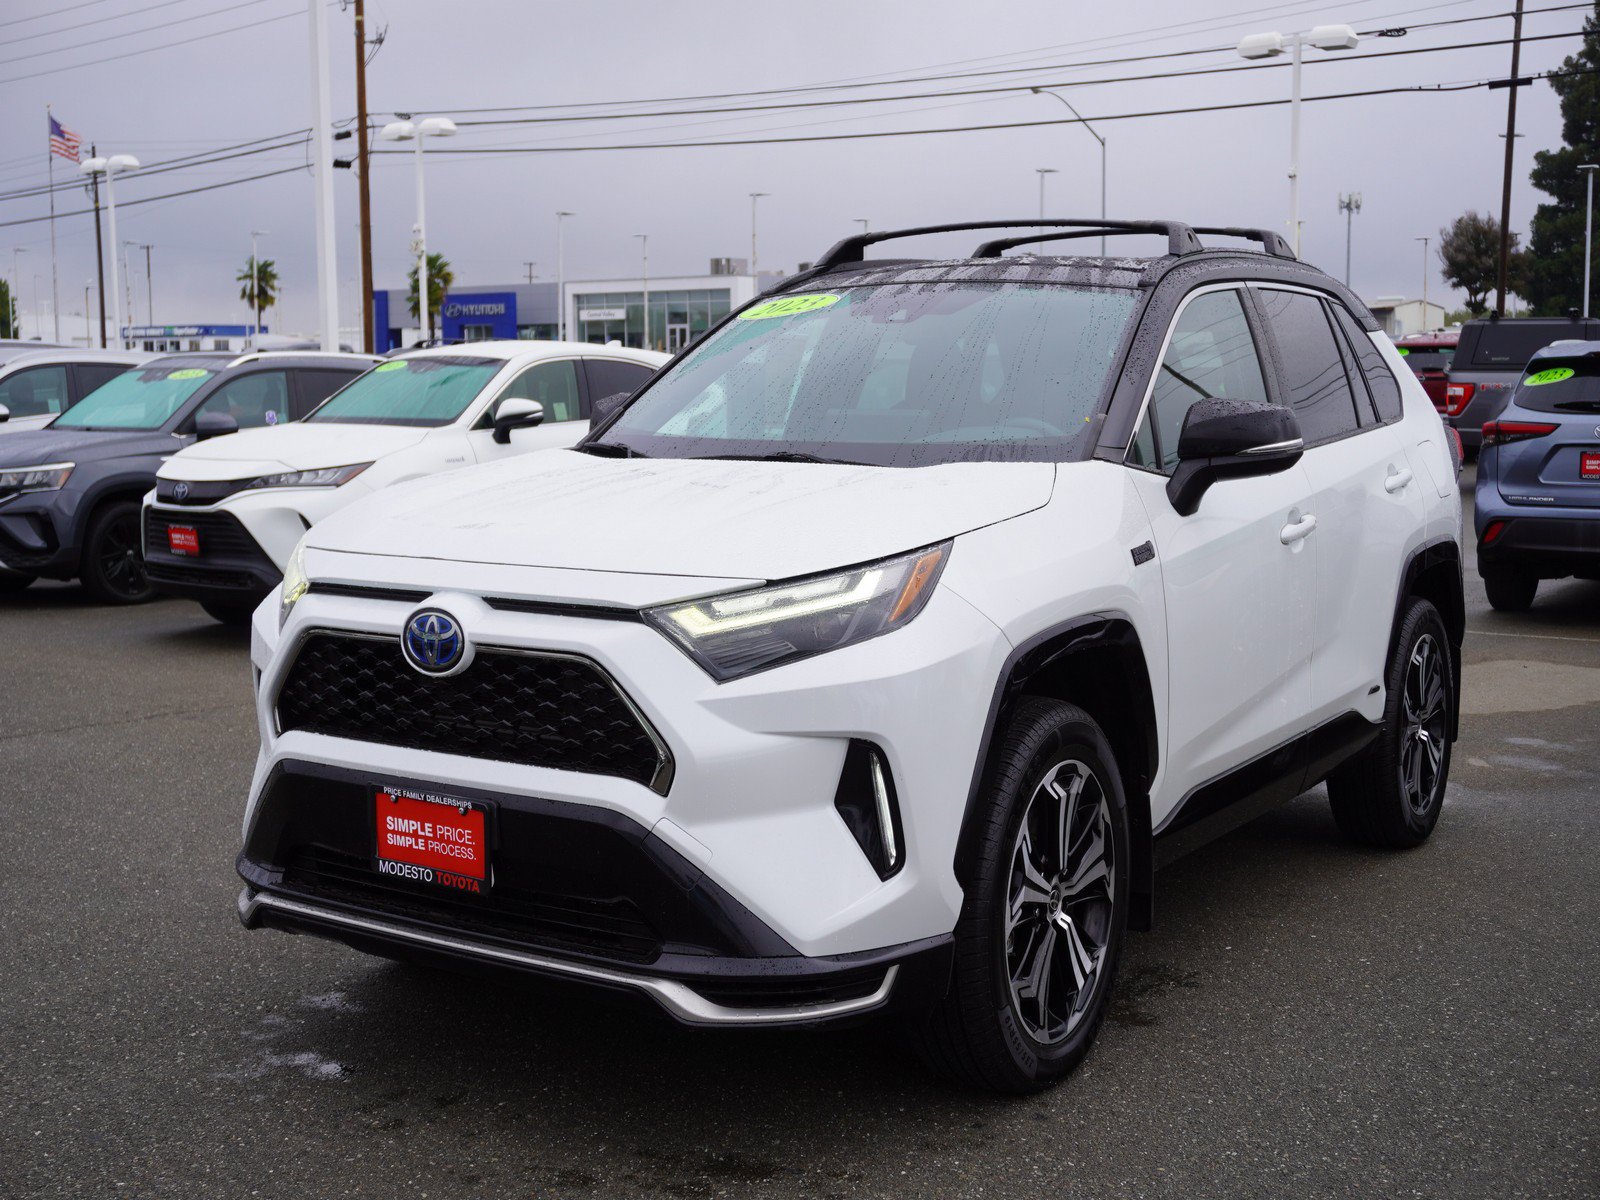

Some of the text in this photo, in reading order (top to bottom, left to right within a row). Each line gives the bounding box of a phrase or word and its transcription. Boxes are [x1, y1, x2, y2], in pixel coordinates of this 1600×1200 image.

[462, 303, 505, 316] HYUNDAI
[383, 786, 472, 809] PRICE FAMILY DEALERSHIPS
[386, 815, 476, 845] SIMPLE PRICE.
[386, 833, 477, 860] SIMPLE PROCESS.
[379, 860, 480, 893] MODESTO TOYOTA
